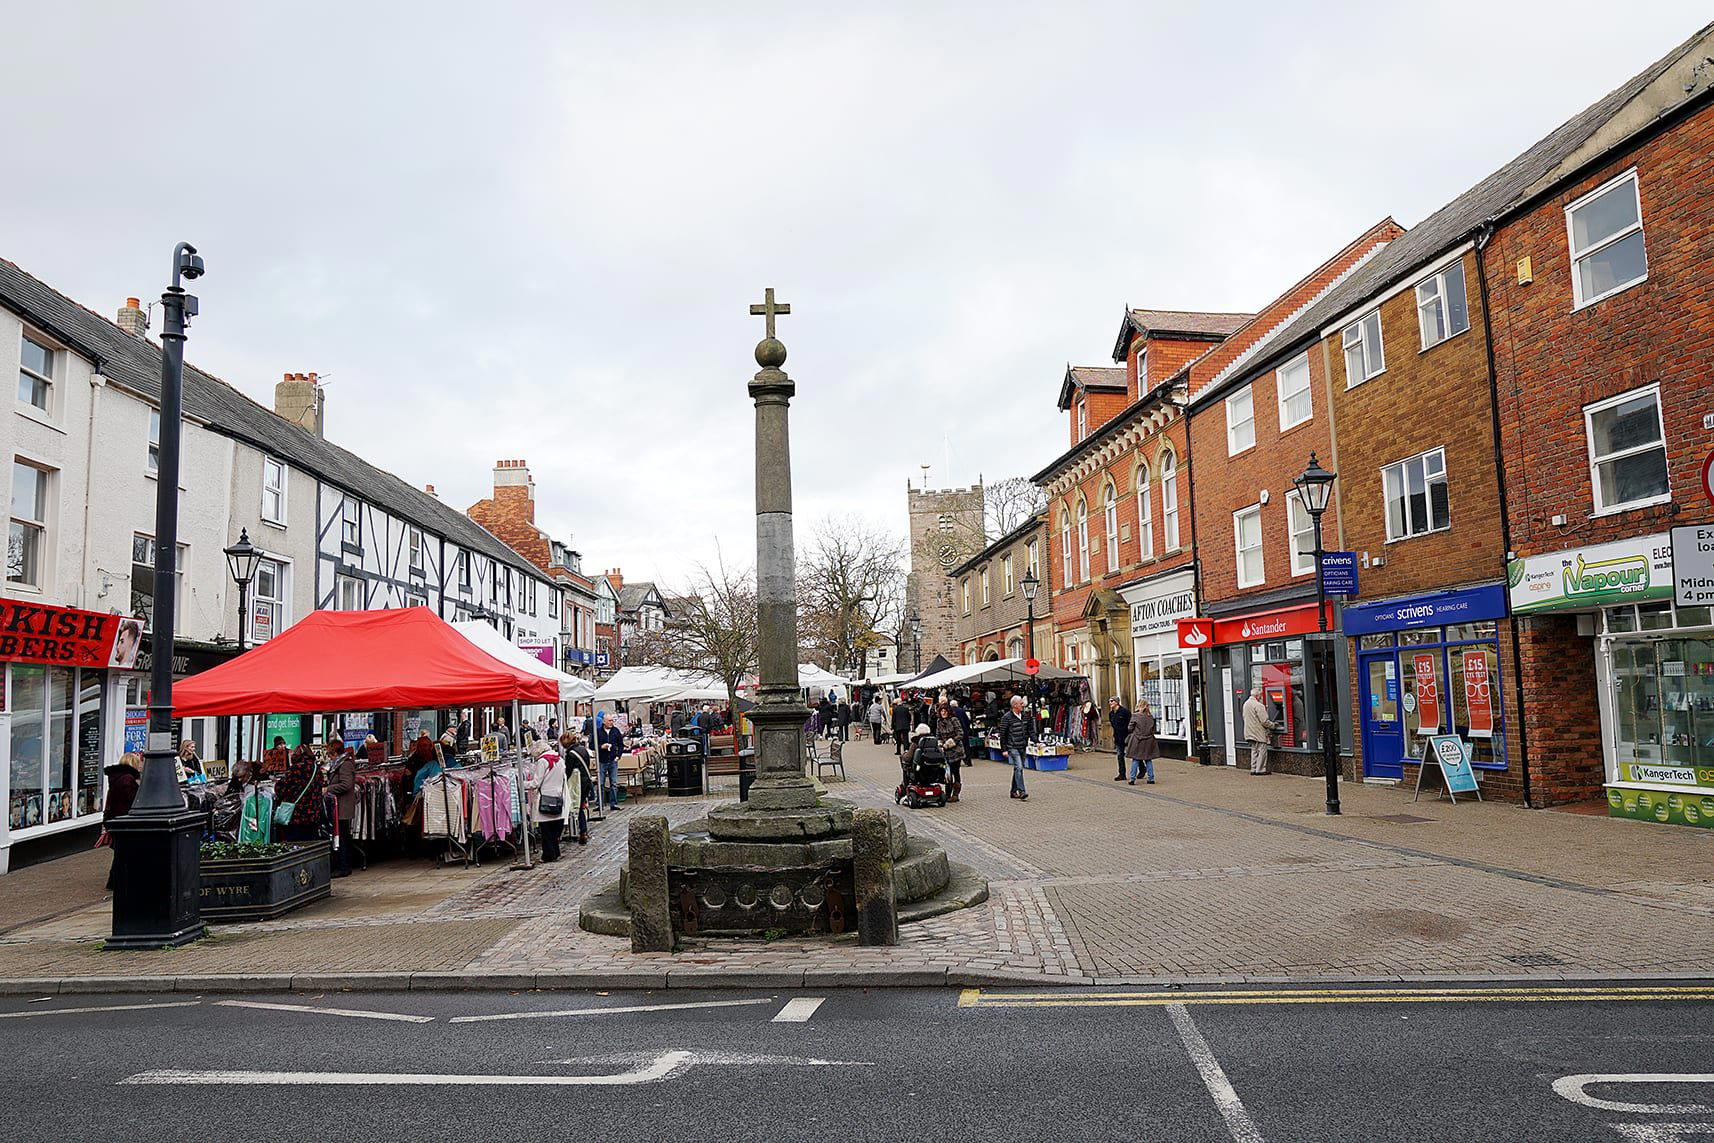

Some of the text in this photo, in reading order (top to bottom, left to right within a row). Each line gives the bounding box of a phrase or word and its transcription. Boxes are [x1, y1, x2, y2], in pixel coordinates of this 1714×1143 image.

[1321, 555, 1352, 565] crivens
[1563, 553, 1645, 592] Vapour
[1620, 583, 1645, 593] corner
[1684, 591, 1693, 599] 4
[1133, 592, 1193, 622] AFTON COACHES
[1375, 613, 1394, 621] OPTICIANS
[1397, 604, 1433, 620] scrivens
[1436, 604, 1456, 613] HEARING
[0, 605, 107, 640] KISH
[1251, 618, 1286, 636] Santander
[1, 636, 75, 660] BERS
[1419, 661, 1431, 673] £15
[1468, 658, 1483, 671] £15
[267, 717, 300, 731] and get fresh
[1644, 768, 1694, 781] KangerTech
[216, 885, 250, 896] WYRE
